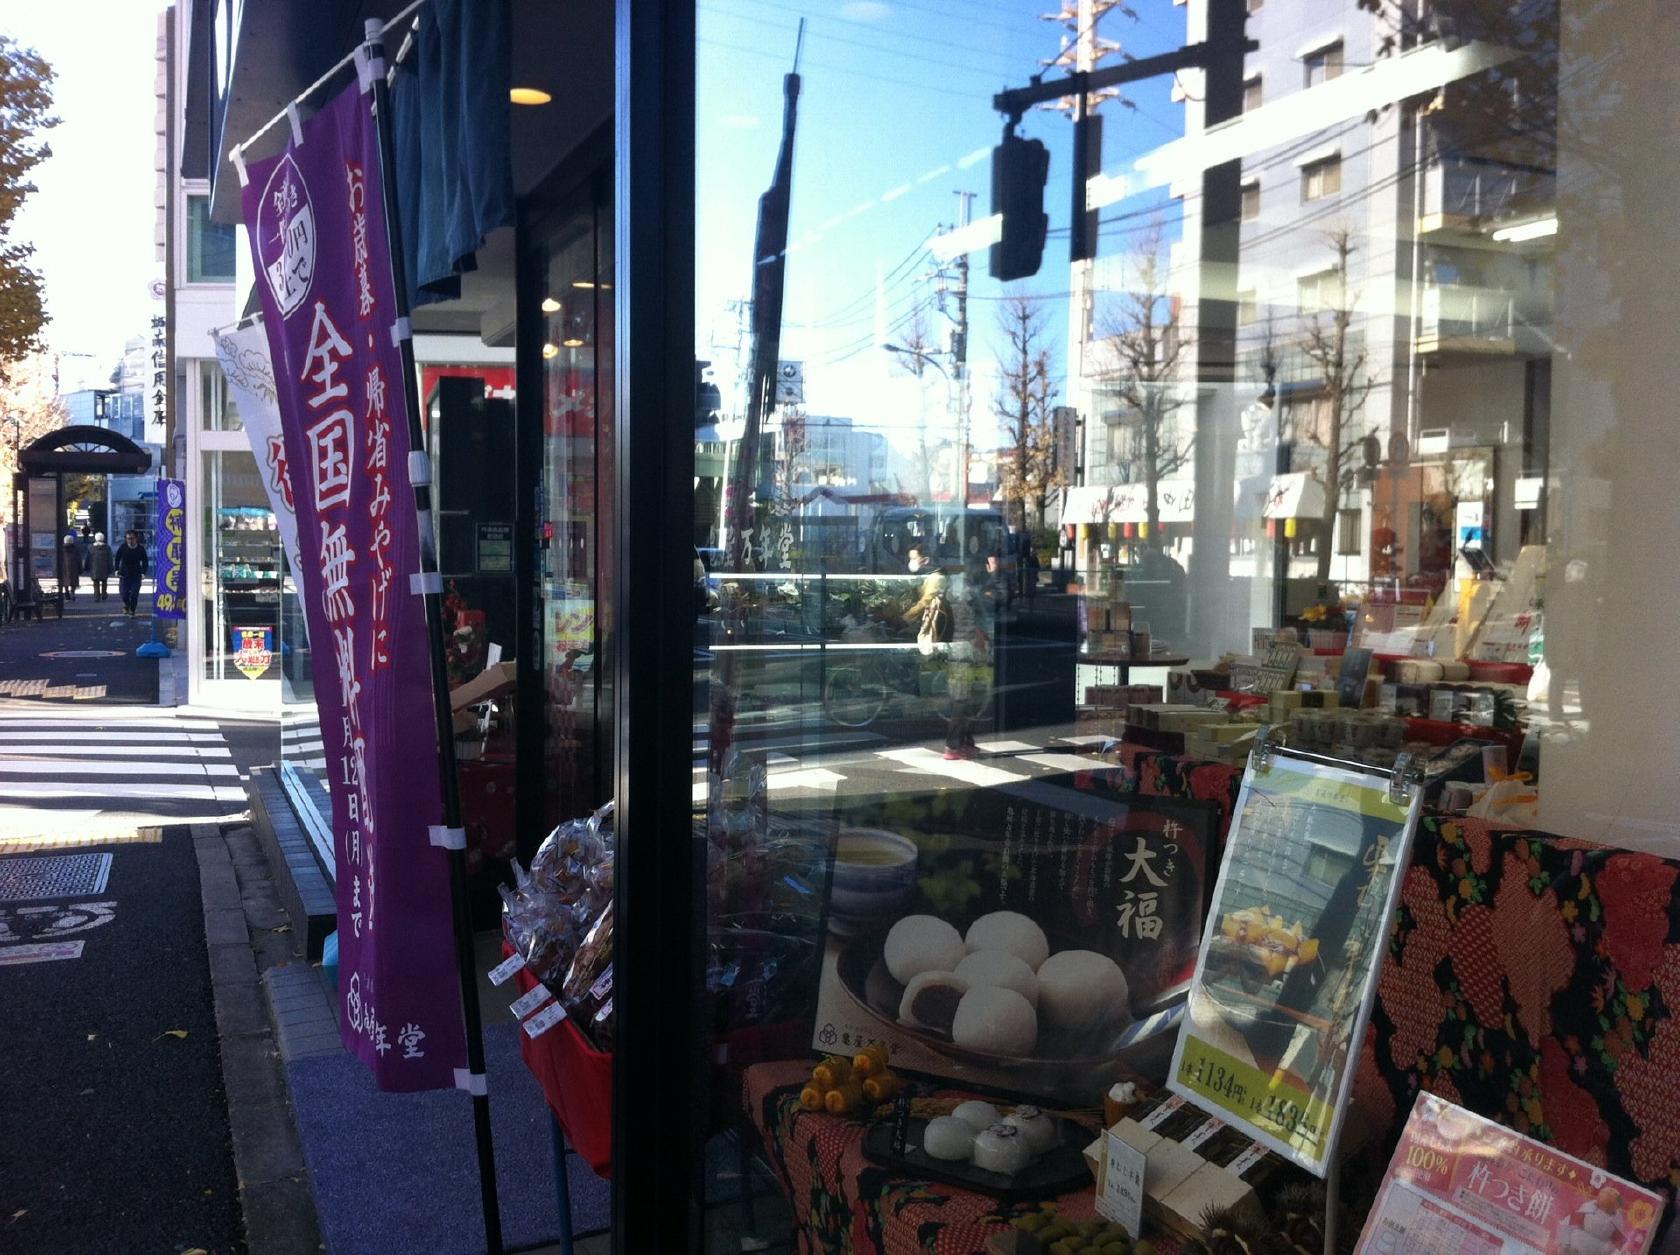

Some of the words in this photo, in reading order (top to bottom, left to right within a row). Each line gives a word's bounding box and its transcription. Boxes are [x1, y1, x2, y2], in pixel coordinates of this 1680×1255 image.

[346, 164, 395, 671] お歳暮・帰省みやげに
[1162, 818, 1183, 878] 杵つき
[1116, 836, 1169, 941] 大福
[1405, 1145, 1449, 1176] 100%
[1466, 1159, 1555, 1226] 杵つき餅
